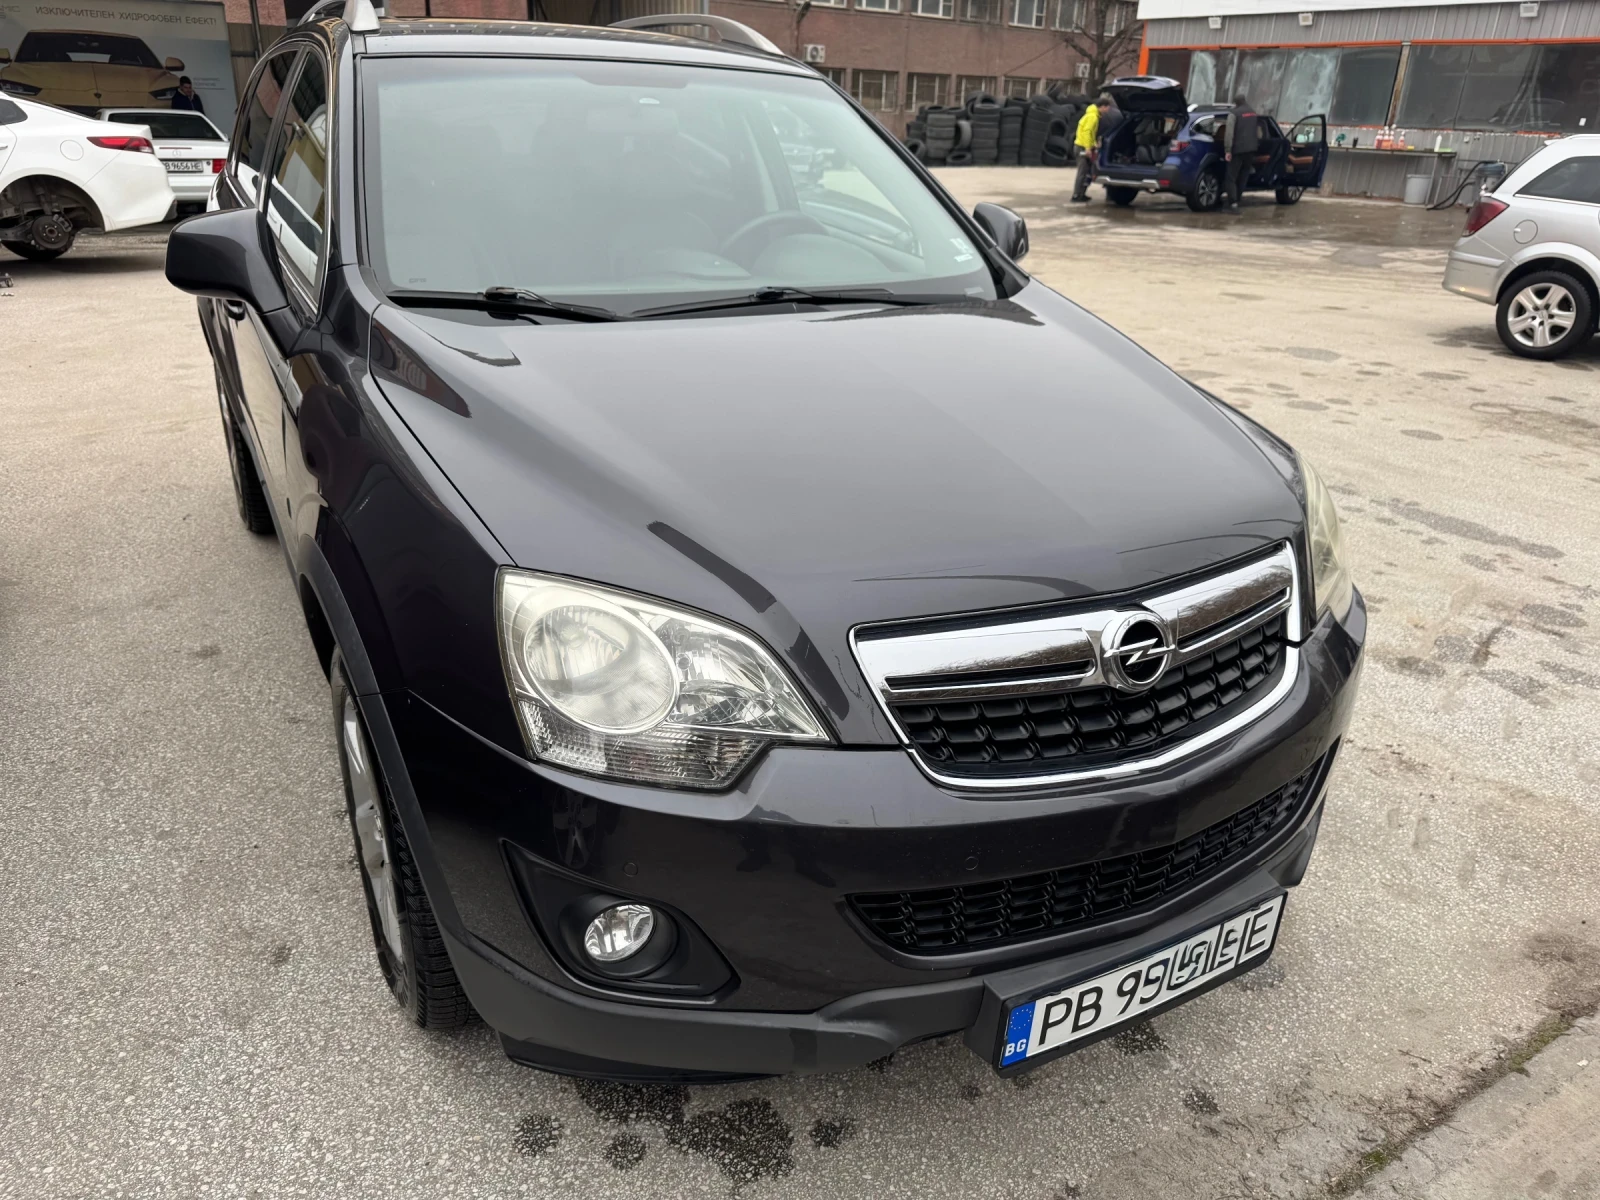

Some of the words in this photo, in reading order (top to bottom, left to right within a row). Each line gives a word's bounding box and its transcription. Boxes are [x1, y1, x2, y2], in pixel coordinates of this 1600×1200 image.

[35, 6, 115, 18] ИЗКЛЮЧИТЕЛЕН
[119, 12, 181, 23] ХИДРОФОБЕН
[186, 16, 217, 25] ЕФЕКТ!
[1038, 986, 1104, 1046] PB
[1005, 1038, 1027, 1056] BG
